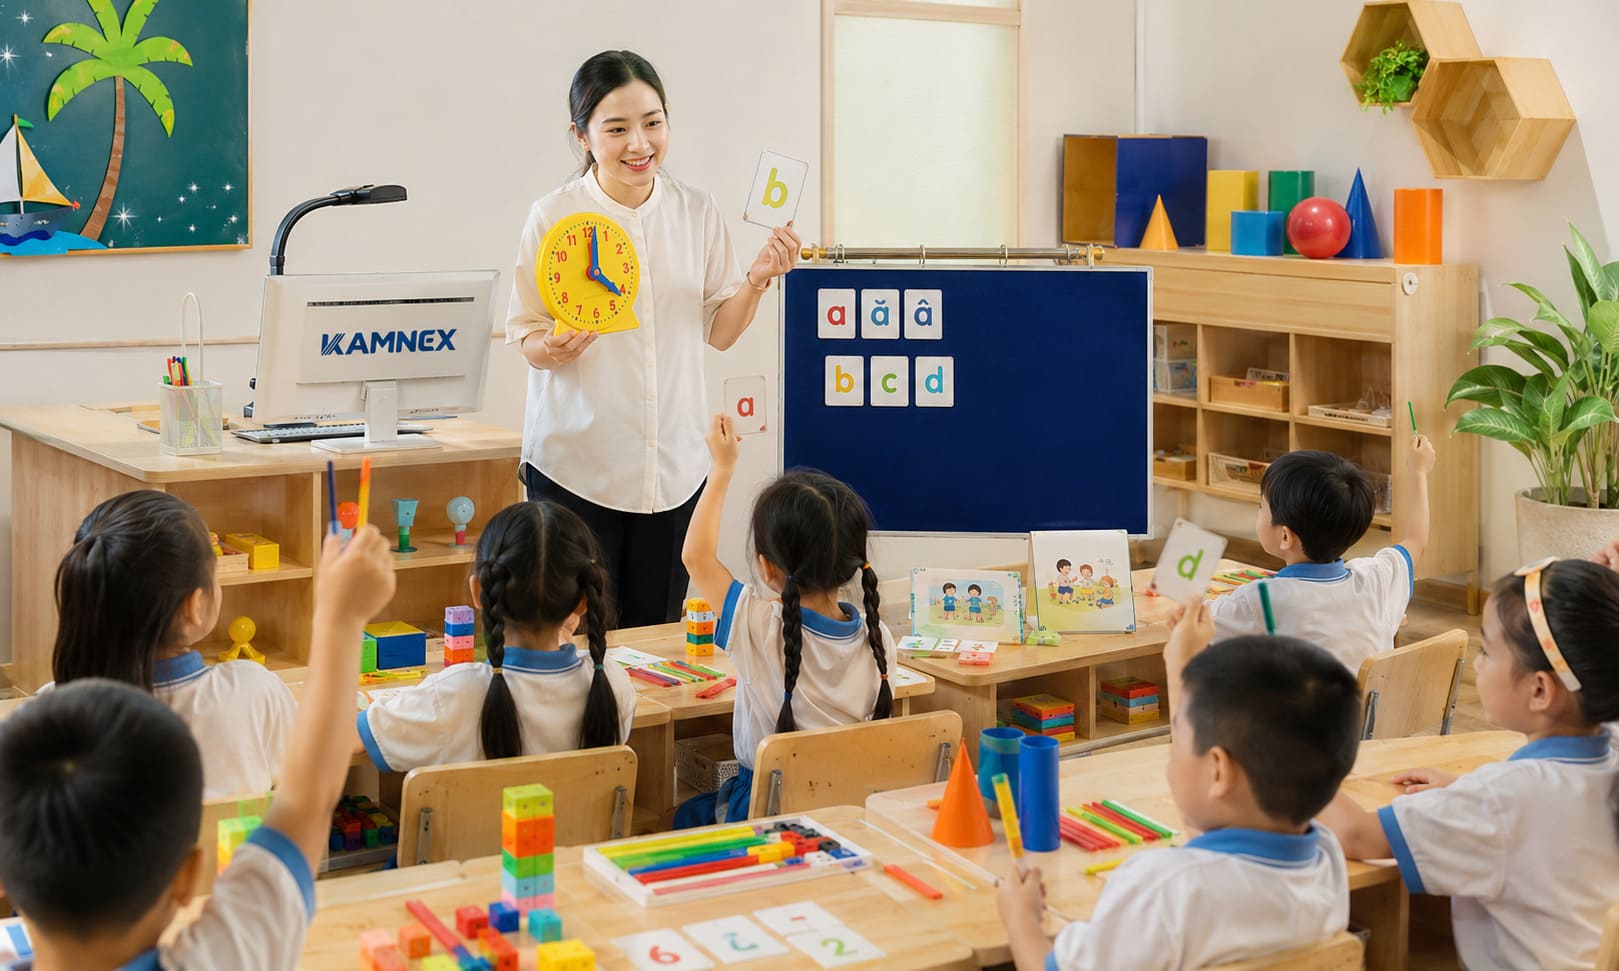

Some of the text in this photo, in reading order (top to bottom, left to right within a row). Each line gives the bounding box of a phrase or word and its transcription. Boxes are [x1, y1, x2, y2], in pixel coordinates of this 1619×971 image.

[762, 167, 788, 208] b
[582, 226, 593, 238] 12
[603, 230, 609, 241] 1
[566, 234, 577, 246] 11
[615, 243, 623, 254] 2
[555, 250, 568, 263] 10
[623, 262, 630, 274] 3
[554, 272, 561, 283] 9
[561, 292, 569, 304] 8
[576, 304, 583, 315] 7
[609, 300, 616, 311] 5
[593, 307, 600, 319] 6
[827, 299, 933, 326] a ă â
[321, 328, 457, 356] KAMNEX
[835, 365, 944, 394] b c d
[737, 397, 754, 417] a
[1177, 549, 1204, 581] d
[820, 937, 859, 957] 2
[649, 944, 682, 965] 6
